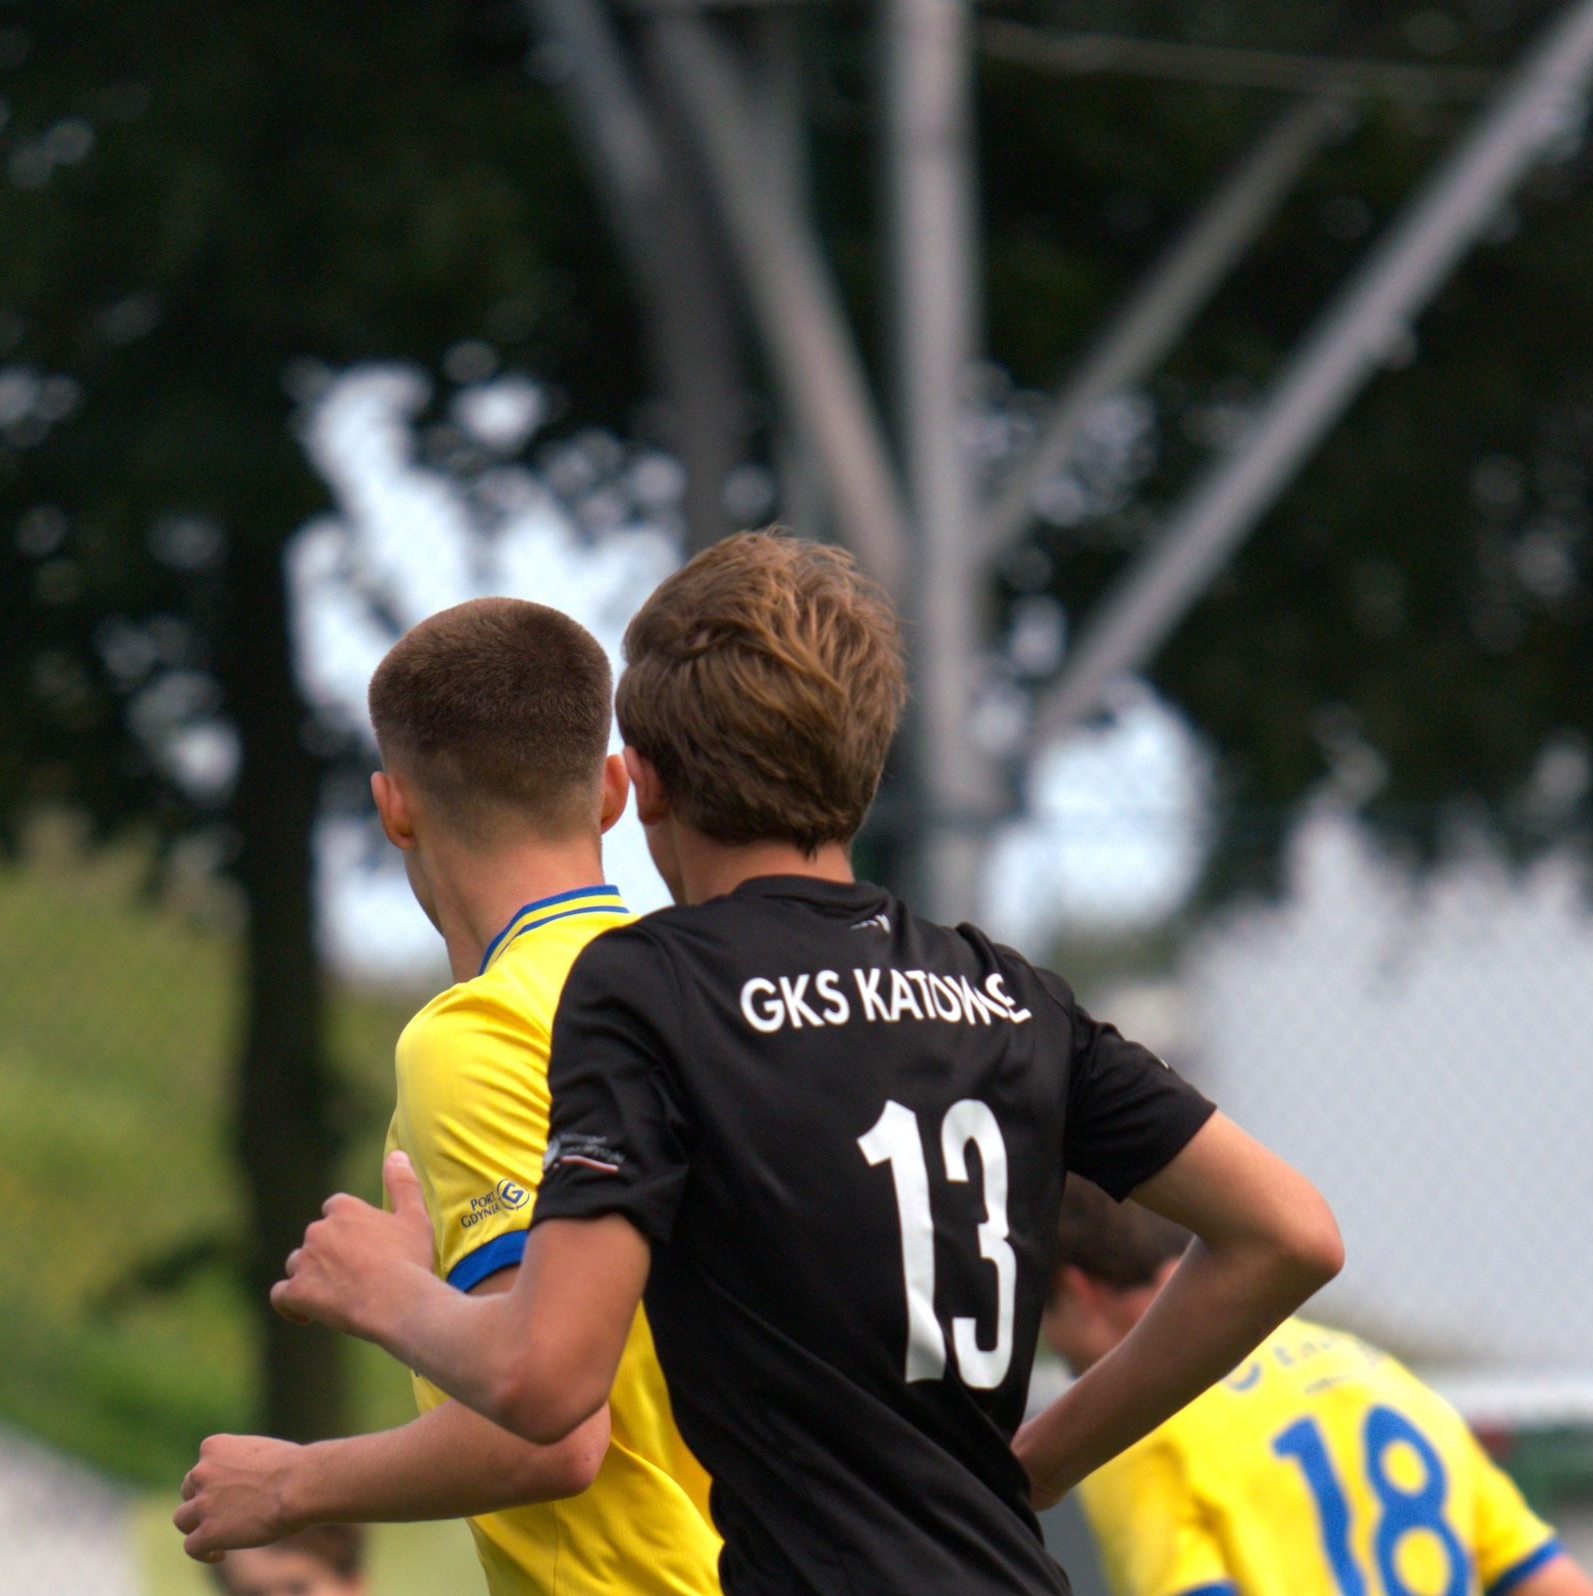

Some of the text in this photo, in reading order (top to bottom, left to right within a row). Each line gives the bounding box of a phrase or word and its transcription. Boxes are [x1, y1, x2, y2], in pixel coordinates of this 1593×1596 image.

[740, 969, 850, 1033] GKS
[460, 1203, 501, 1228] GDYNIA
[470, 1191, 497, 1211] PORT
[856, 1098, 1018, 1390] 13
